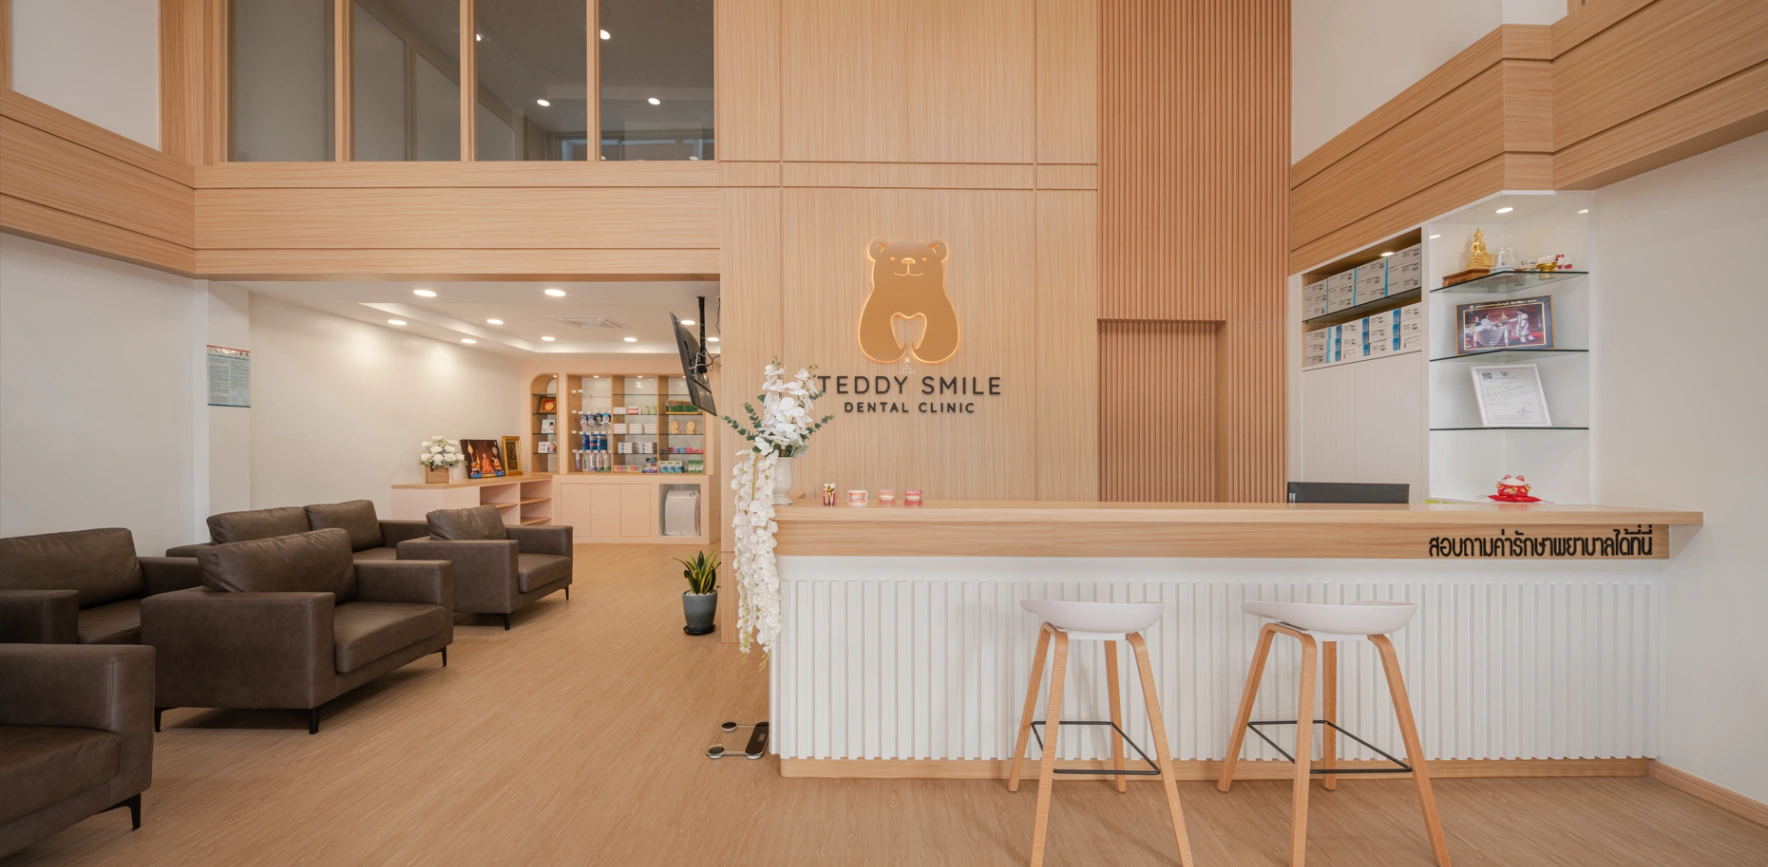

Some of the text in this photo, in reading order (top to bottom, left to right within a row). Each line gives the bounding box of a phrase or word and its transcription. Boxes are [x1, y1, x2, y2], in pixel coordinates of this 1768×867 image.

[817, 375, 1002, 395] TEDDY SMILE
[844, 402, 975, 413] DENTAL CLINIC
[1428, 524, 1653, 557] สอบถามค่ารักษาพยาบาลได้ที่นี่
